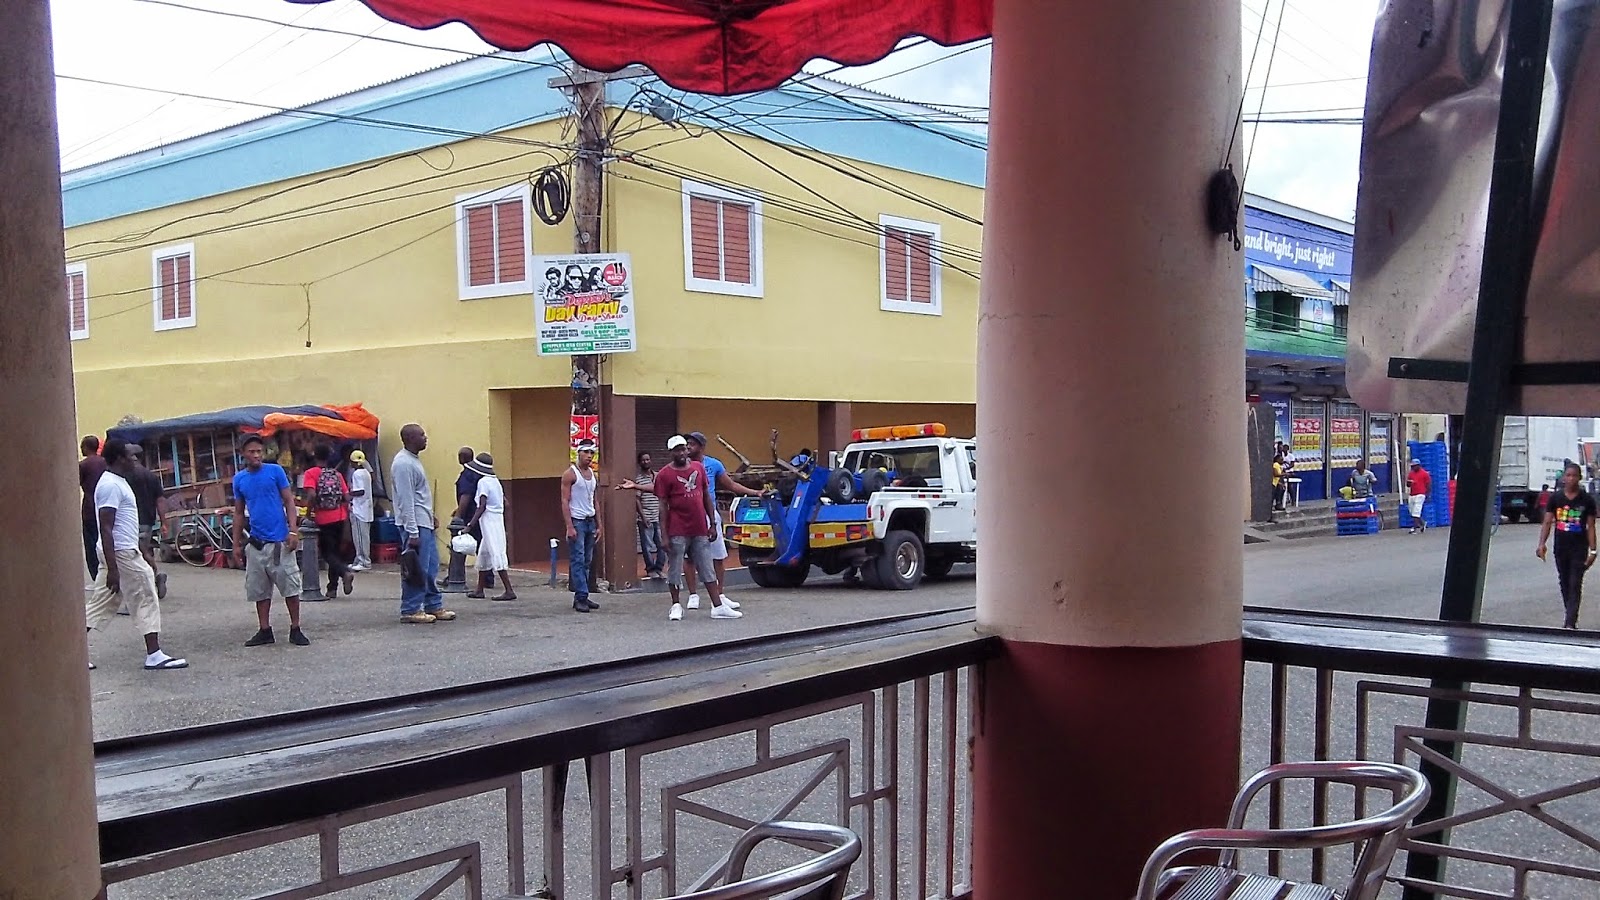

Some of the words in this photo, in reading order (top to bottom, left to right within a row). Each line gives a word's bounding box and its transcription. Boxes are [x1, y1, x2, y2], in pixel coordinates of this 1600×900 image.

[1245, 231, 1263, 251] and
[1264, 232, 1294, 261] bright,
[1293, 242, 1311, 264] just
[1311, 247, 1335, 270] right!
[545, 304, 577, 323] Day
[577, 301, 620, 318] Party
